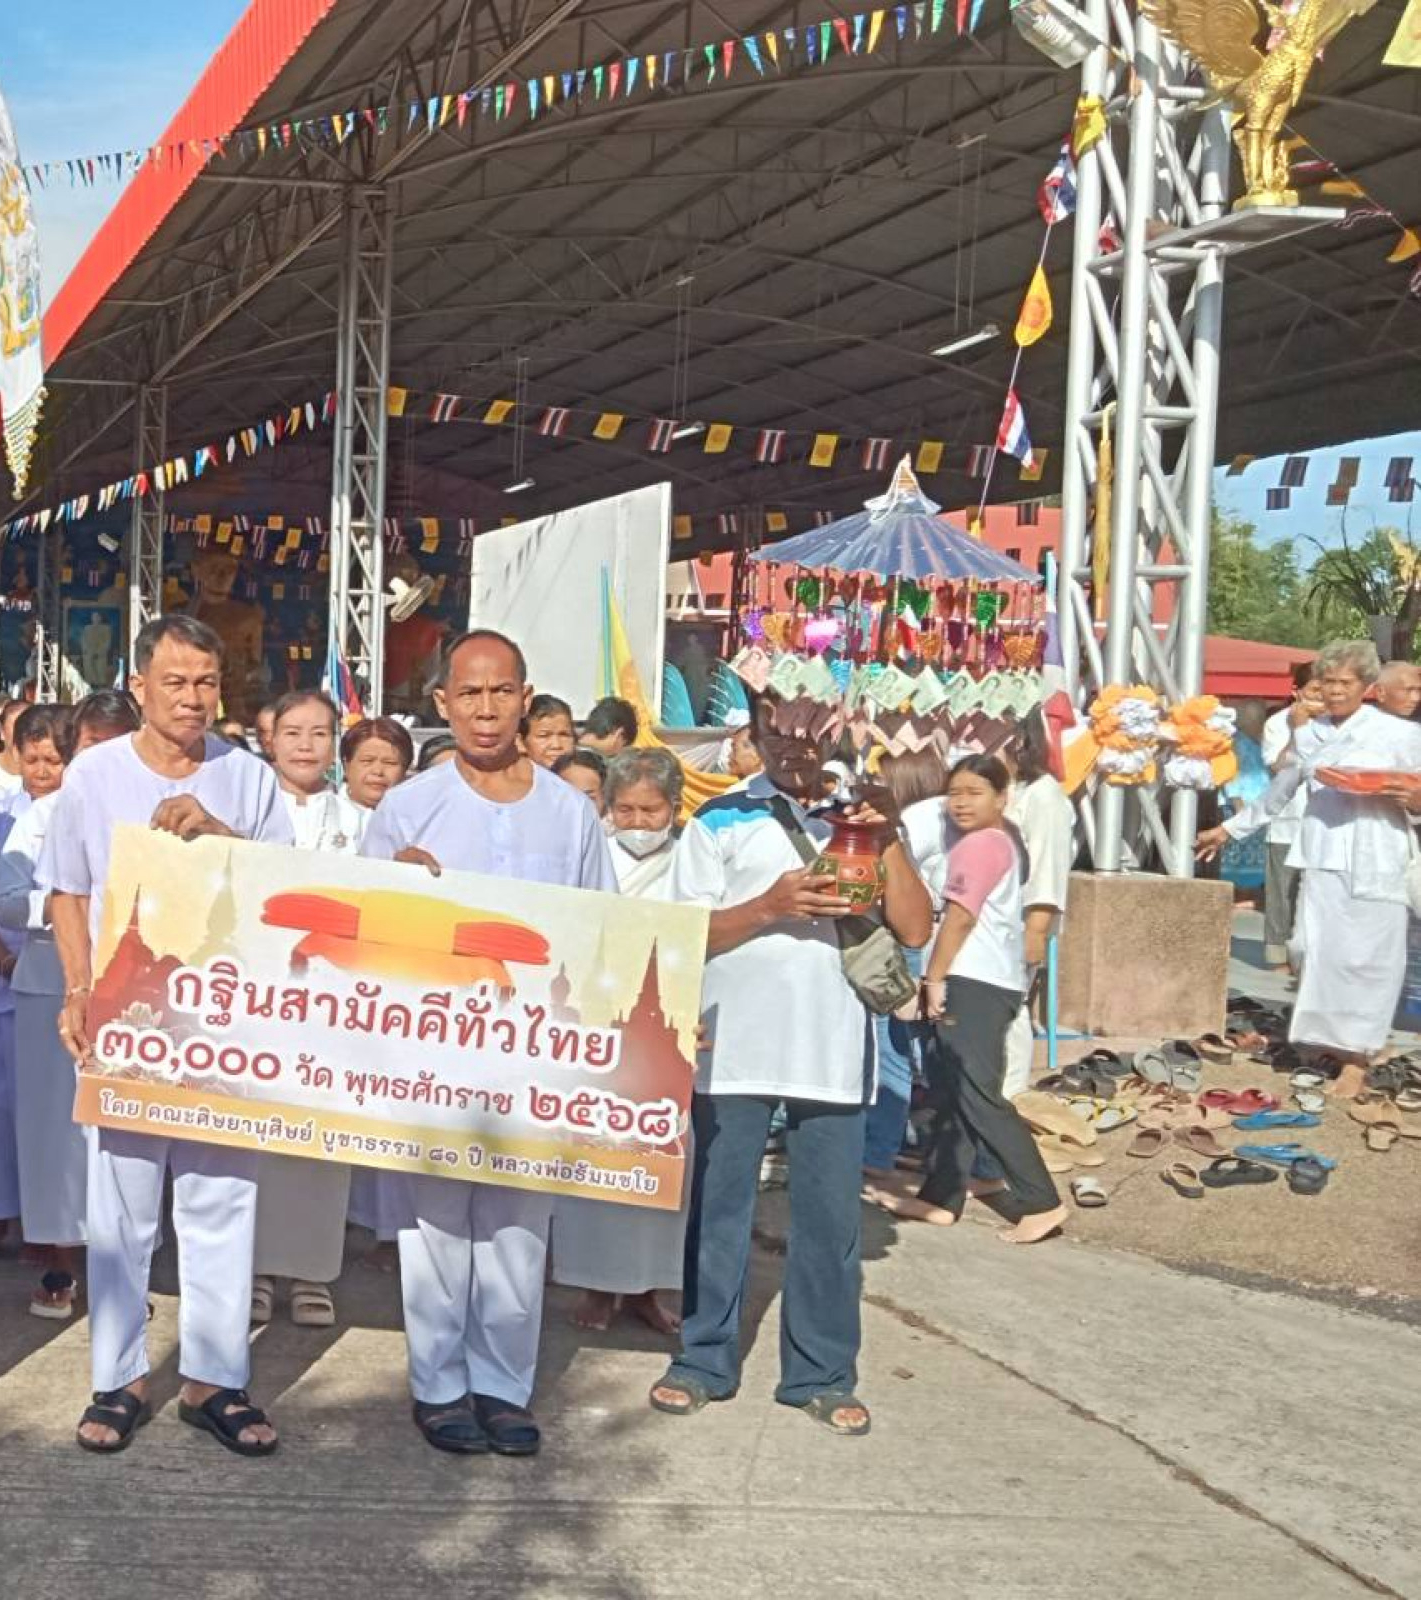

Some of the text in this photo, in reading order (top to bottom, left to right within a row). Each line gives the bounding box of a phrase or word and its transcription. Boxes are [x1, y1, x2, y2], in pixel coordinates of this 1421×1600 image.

[175, 960, 616, 1067] กฐินสามัคคีทั่วไทย
[101, 1029, 672, 1138] ๓๐,๐๐๐ วัด พุทธศักราช ๒๕๖๘
[101, 1091, 139, 1115] โดย
[148, 1105, 313, 1143] คณะศิษยานุศิษย์
[322, 1128, 420, 1158] บูชาธรรม
[468, 1146, 482, 1167] ปี
